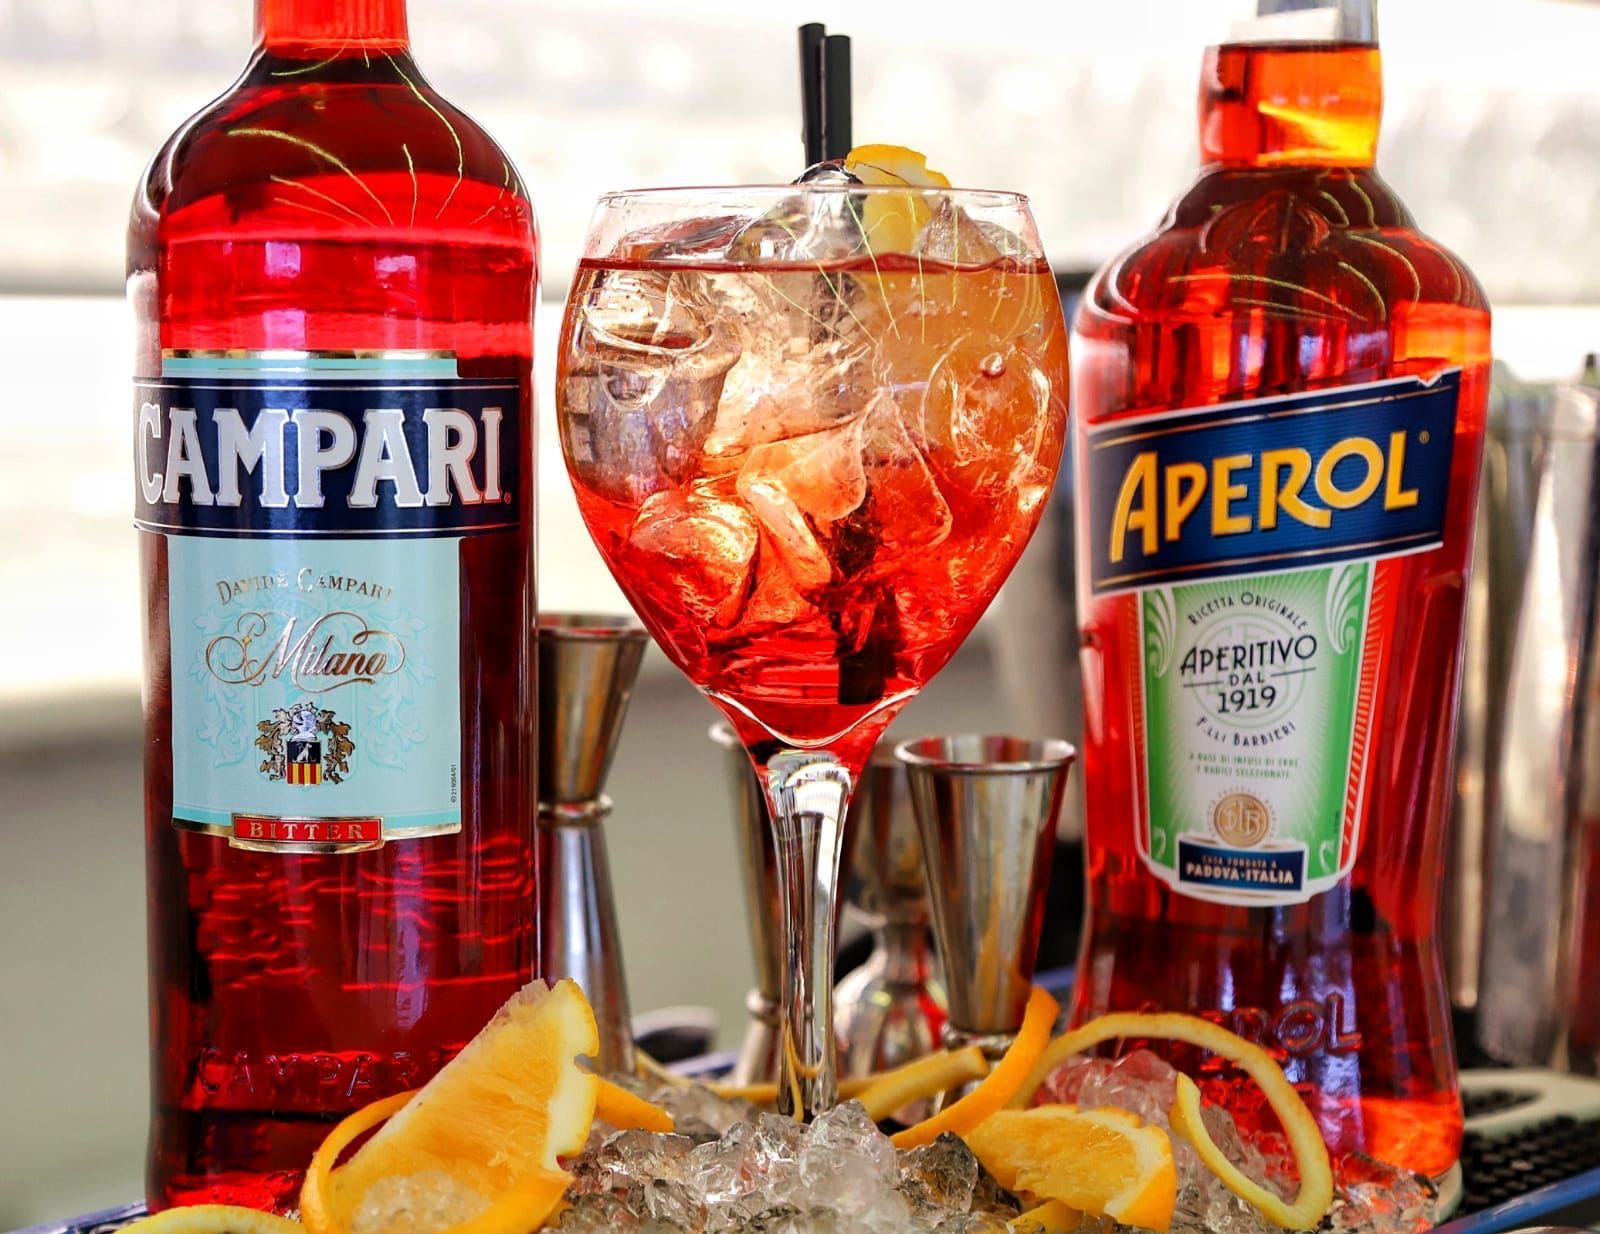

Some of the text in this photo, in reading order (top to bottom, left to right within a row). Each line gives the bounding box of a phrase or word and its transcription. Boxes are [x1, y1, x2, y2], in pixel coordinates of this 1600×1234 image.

[137, 401, 503, 508] CAMPARI
[1109, 430, 1418, 563] APEROL
[216, 567, 394, 605] DAVIDE CAMPARI
[1188, 592, 1308, 631] RICETTA ORIGINALE
[206, 612, 405, 693] Milano
[1180, 635, 1318, 677] APERITIVO
[1229, 671, 1266, 688] DAL
[1218, 686, 1277, 714] 1919
[1233, 721, 1297, 748] BARBIERI
[249, 822, 364, 840] BITTER
